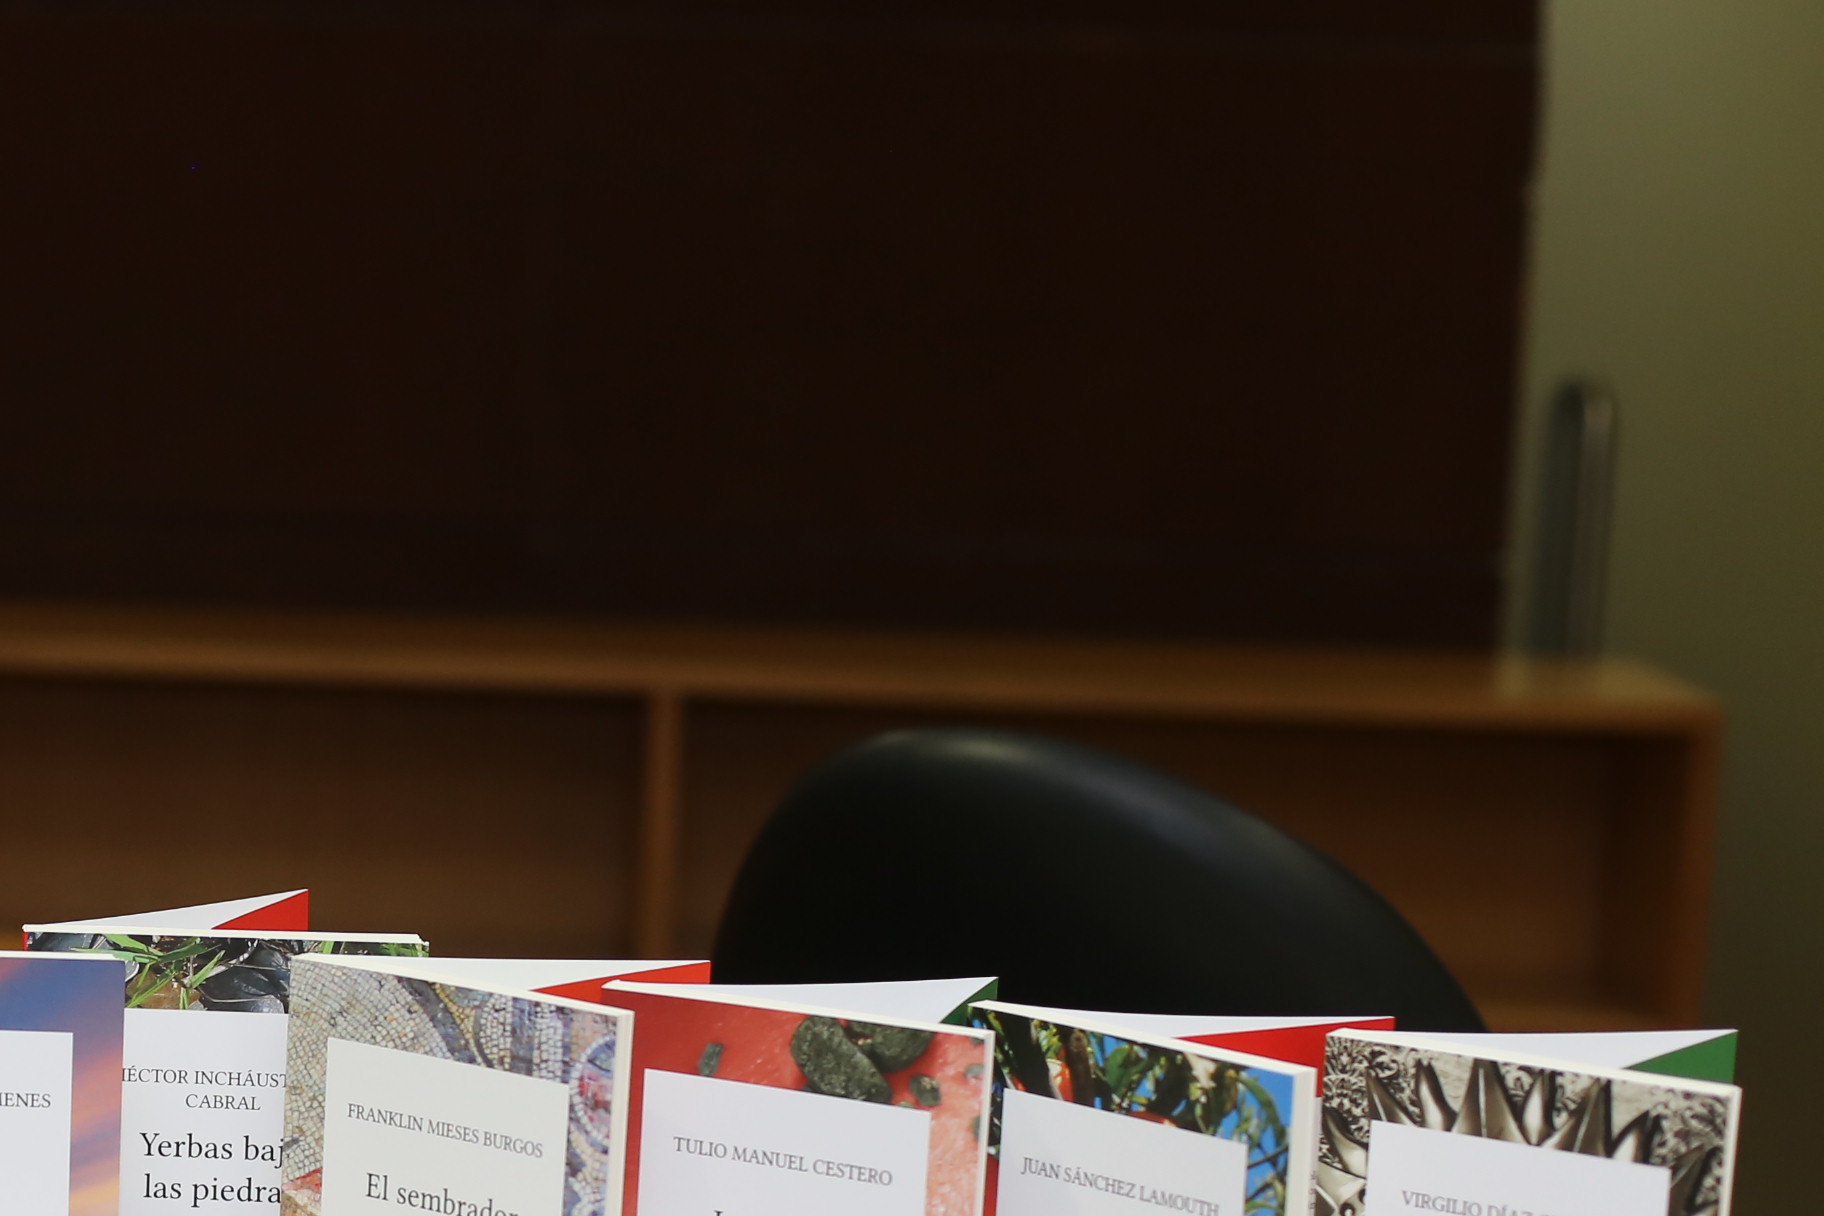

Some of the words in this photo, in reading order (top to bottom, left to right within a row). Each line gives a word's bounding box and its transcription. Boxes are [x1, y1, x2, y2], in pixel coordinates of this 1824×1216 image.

[186, 1093, 260, 1110] CABRAL
[348, 1103, 423, 1132] FRANKLIN
[426, 1119, 479, 1144] MIESES
[482, 1130, 542, 1158] BURGOS
[140, 1132, 233, 1160] Yerbas
[672, 1136, 727, 1158] TULIO
[732, 1146, 808, 1172] MANUEL
[812, 1159, 892, 1185] CESTERO
[143, 1173, 182, 1199] las
[366, 1172, 388, 1201] El
[1020, 1156, 1061, 1179] JUAN
[1062, 1166, 1136, 1198] SÁNCHEZ
